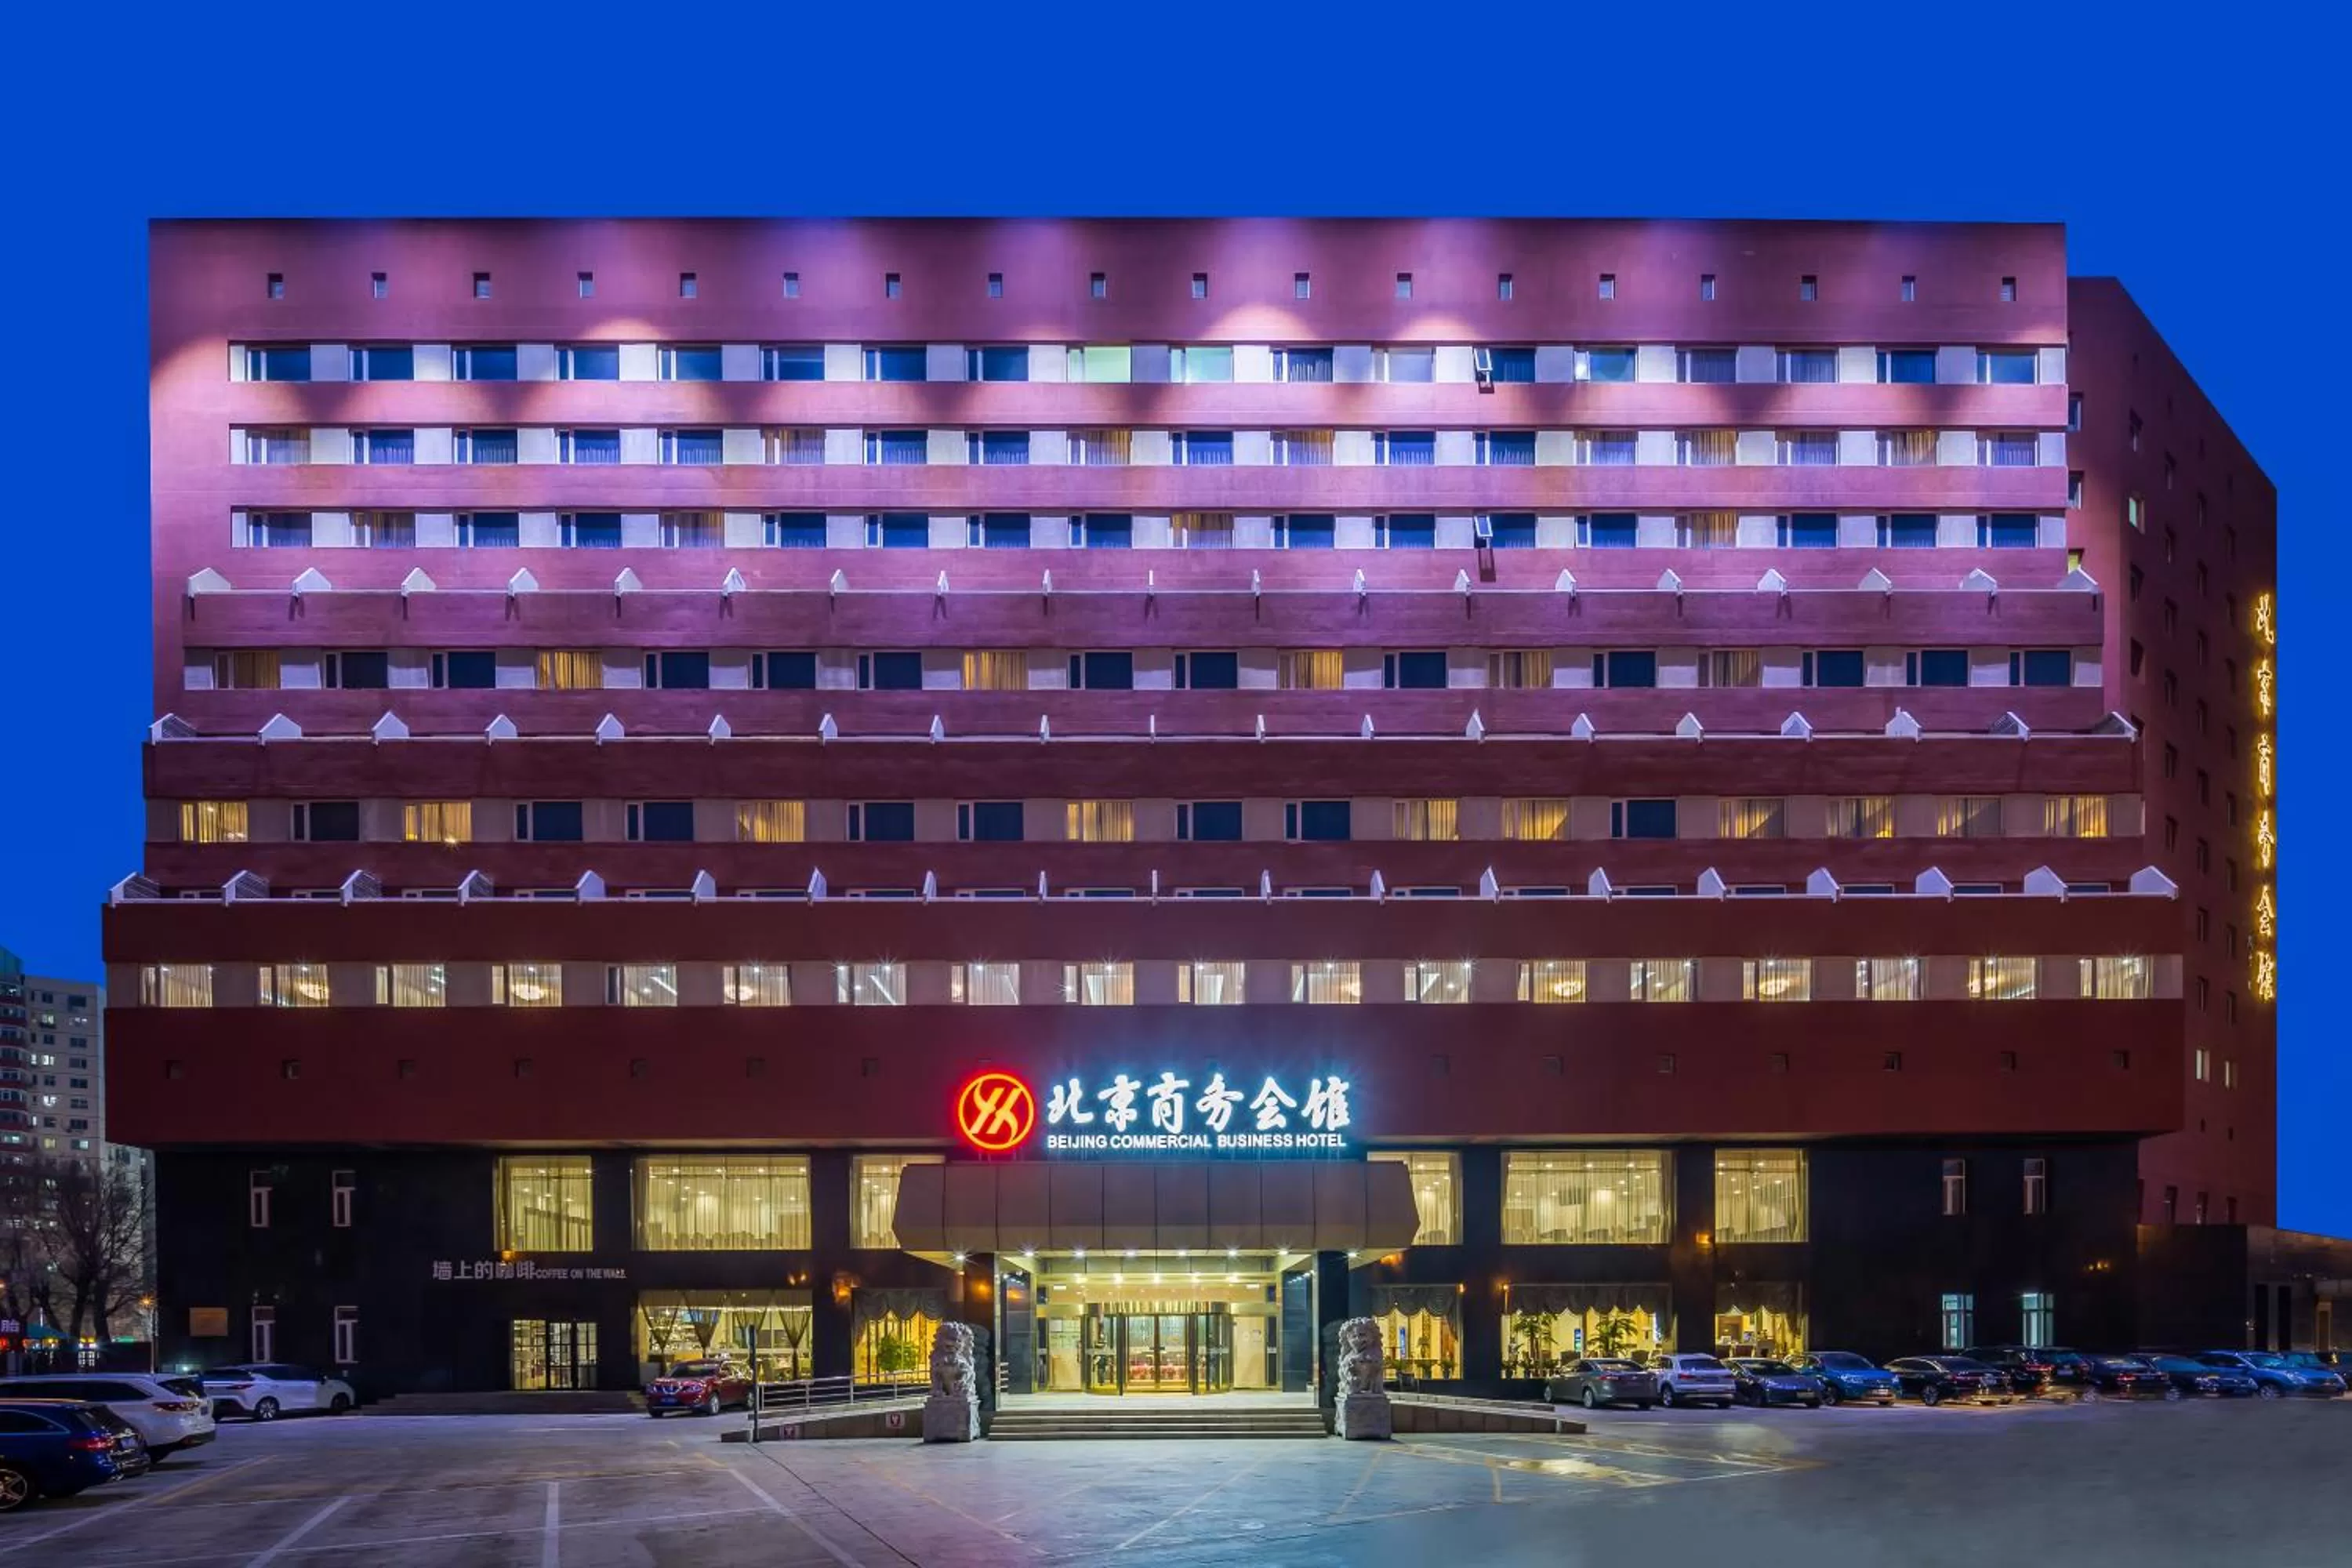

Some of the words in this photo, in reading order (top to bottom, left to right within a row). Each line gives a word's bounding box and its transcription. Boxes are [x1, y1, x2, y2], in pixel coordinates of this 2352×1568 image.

[2256, 593, 2274, 1000] 北京商务会馆
[1047, 1073, 1352, 1132] 北京商务会馆
[1047, 1135, 1108, 1149] BEIJING
[1110, 1135, 1211, 1149] COMMERCIAL
[1218, 1134, 1293, 1148] BUSINESS
[1296, 1134, 1347, 1147] HOTEL
[432, 1260, 535, 1280] 墙上的咖啡
[535, 1269, 568, 1279] COFFEE
[570, 1269, 583, 1279] ON
[586, 1269, 603, 1279] THE
